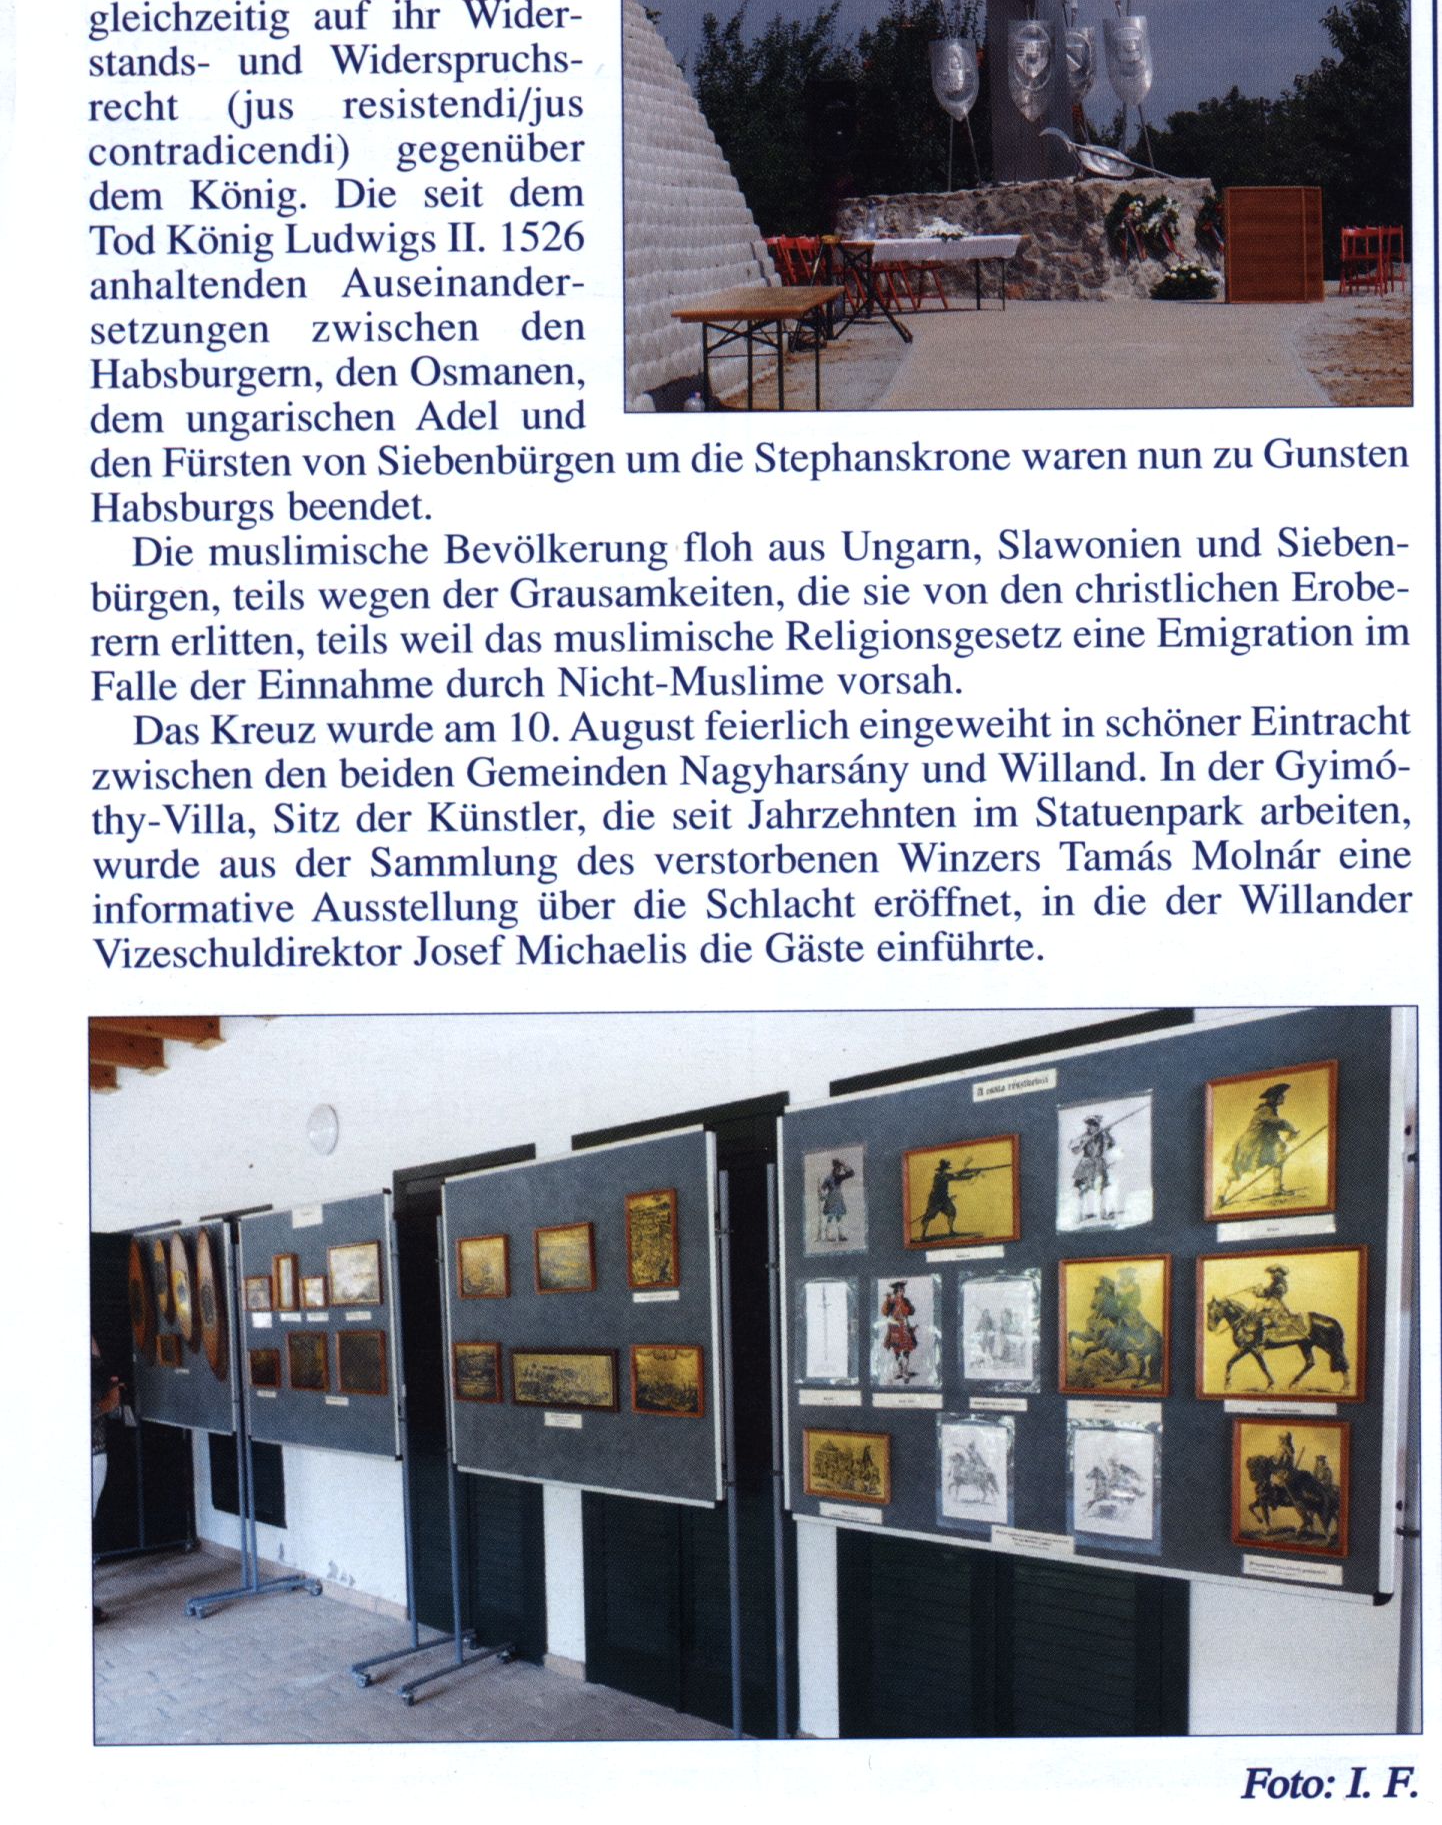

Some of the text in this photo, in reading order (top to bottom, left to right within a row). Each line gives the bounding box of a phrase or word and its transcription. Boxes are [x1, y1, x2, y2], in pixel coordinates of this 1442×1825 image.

[88, 0, 290, 42] gleichzeitig
[89, 86, 584, 130] recht (jus resistendi/jus
[88, 220, 585, 263] Tod König Ludwigs II. 1526
[91, 355, 585, 397] Habsburgern, den Osmanen,
[90, 437, 1409, 484] den Fürsten von Siebenbürgen um die Stephanskrone waren nun zu Gunsten
[133, 526, 1409, 572] Die muslimische Bevölkerung floh aus Ungarn, Slawonien und Sieben-
[92, 663, 962, 702] Falle der Einnahme durch Nicht-Muslime vorsah.
[91, 793, 1411, 844] thy-Villa, Sitz der Künstler, die seit Jahrzehnten im Statuenpark arbeiten,
[93, 930, 1044, 969] Vizeschuldirektor Josef Michaelis die Gäste einführte.
[1240, 1766, 1418, 1800] Foto: I. F.
